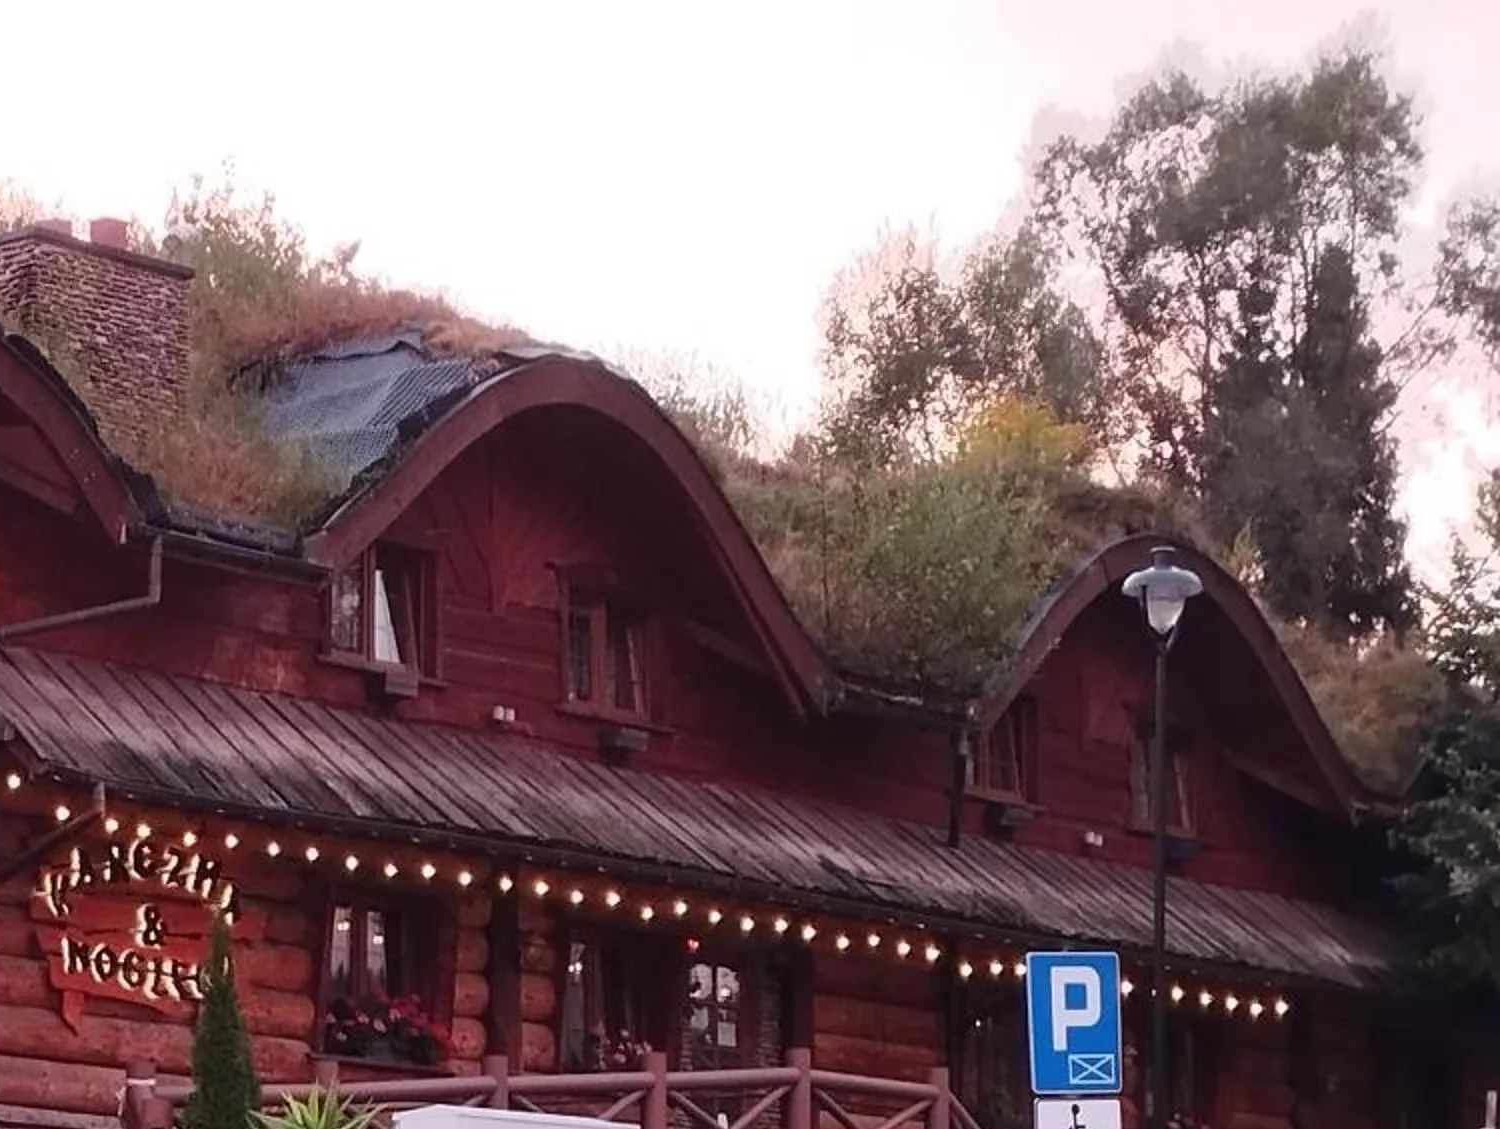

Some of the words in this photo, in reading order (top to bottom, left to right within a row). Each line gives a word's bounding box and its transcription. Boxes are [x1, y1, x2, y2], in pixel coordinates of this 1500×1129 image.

[40, 839, 241, 926] KARCZMA
[134, 903, 166, 950] &
[1051, 966, 1101, 1051] P
